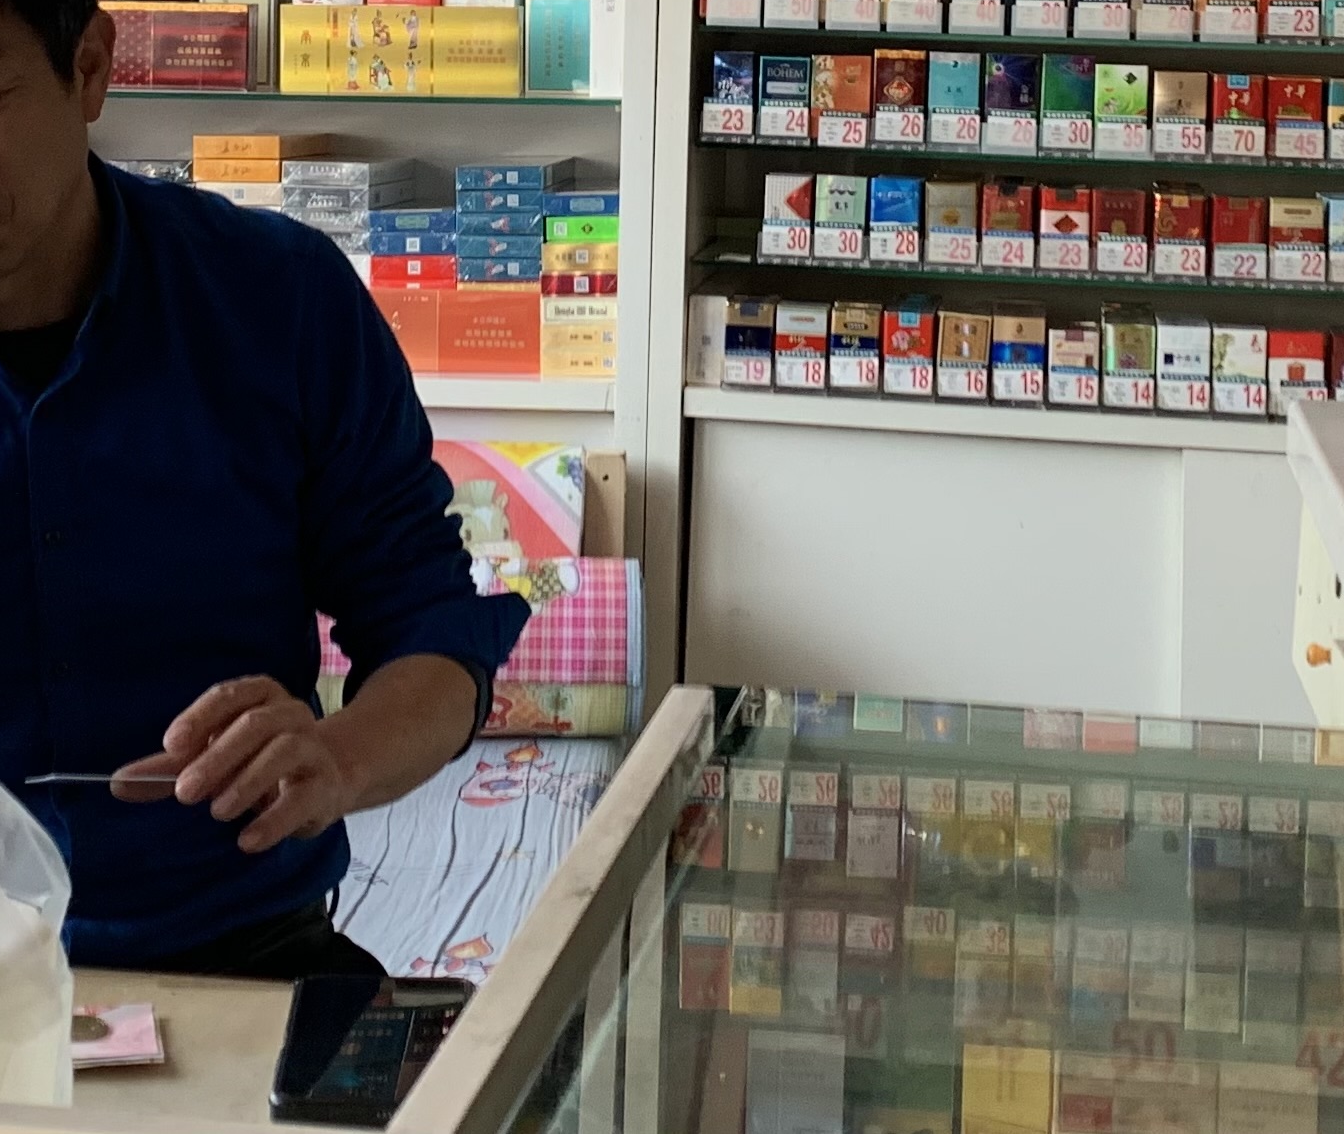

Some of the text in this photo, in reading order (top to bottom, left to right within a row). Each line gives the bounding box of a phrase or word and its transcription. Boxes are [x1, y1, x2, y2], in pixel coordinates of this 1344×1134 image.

[766, 67, 805, 80] BOHEM
[787, 110, 809, 132] 24
[843, 121, 863, 142] 25
[902, 114, 921, 135] 26
[959, 118, 978, 138] 26
[788, 228, 808, 249] 30
[840, 231, 859, 253] 30
[896, 233, 916, 255] 28
[1002, 242, 1024, 265] 24
[1124, 244, 1147, 267] 23
[804, 362, 823, 384] 18
[860, 362, 877, 381] 18
[912, 368, 929, 388] 18
[967, 372, 987, 392] 16
[1021, 372, 1044, 393] 15
[1077, 377, 1095, 400] 15
[1133, 383, 1152, 402] 14
[1189, 385, 1207, 403] 14
[1244, 386, 1264, 406] 14
